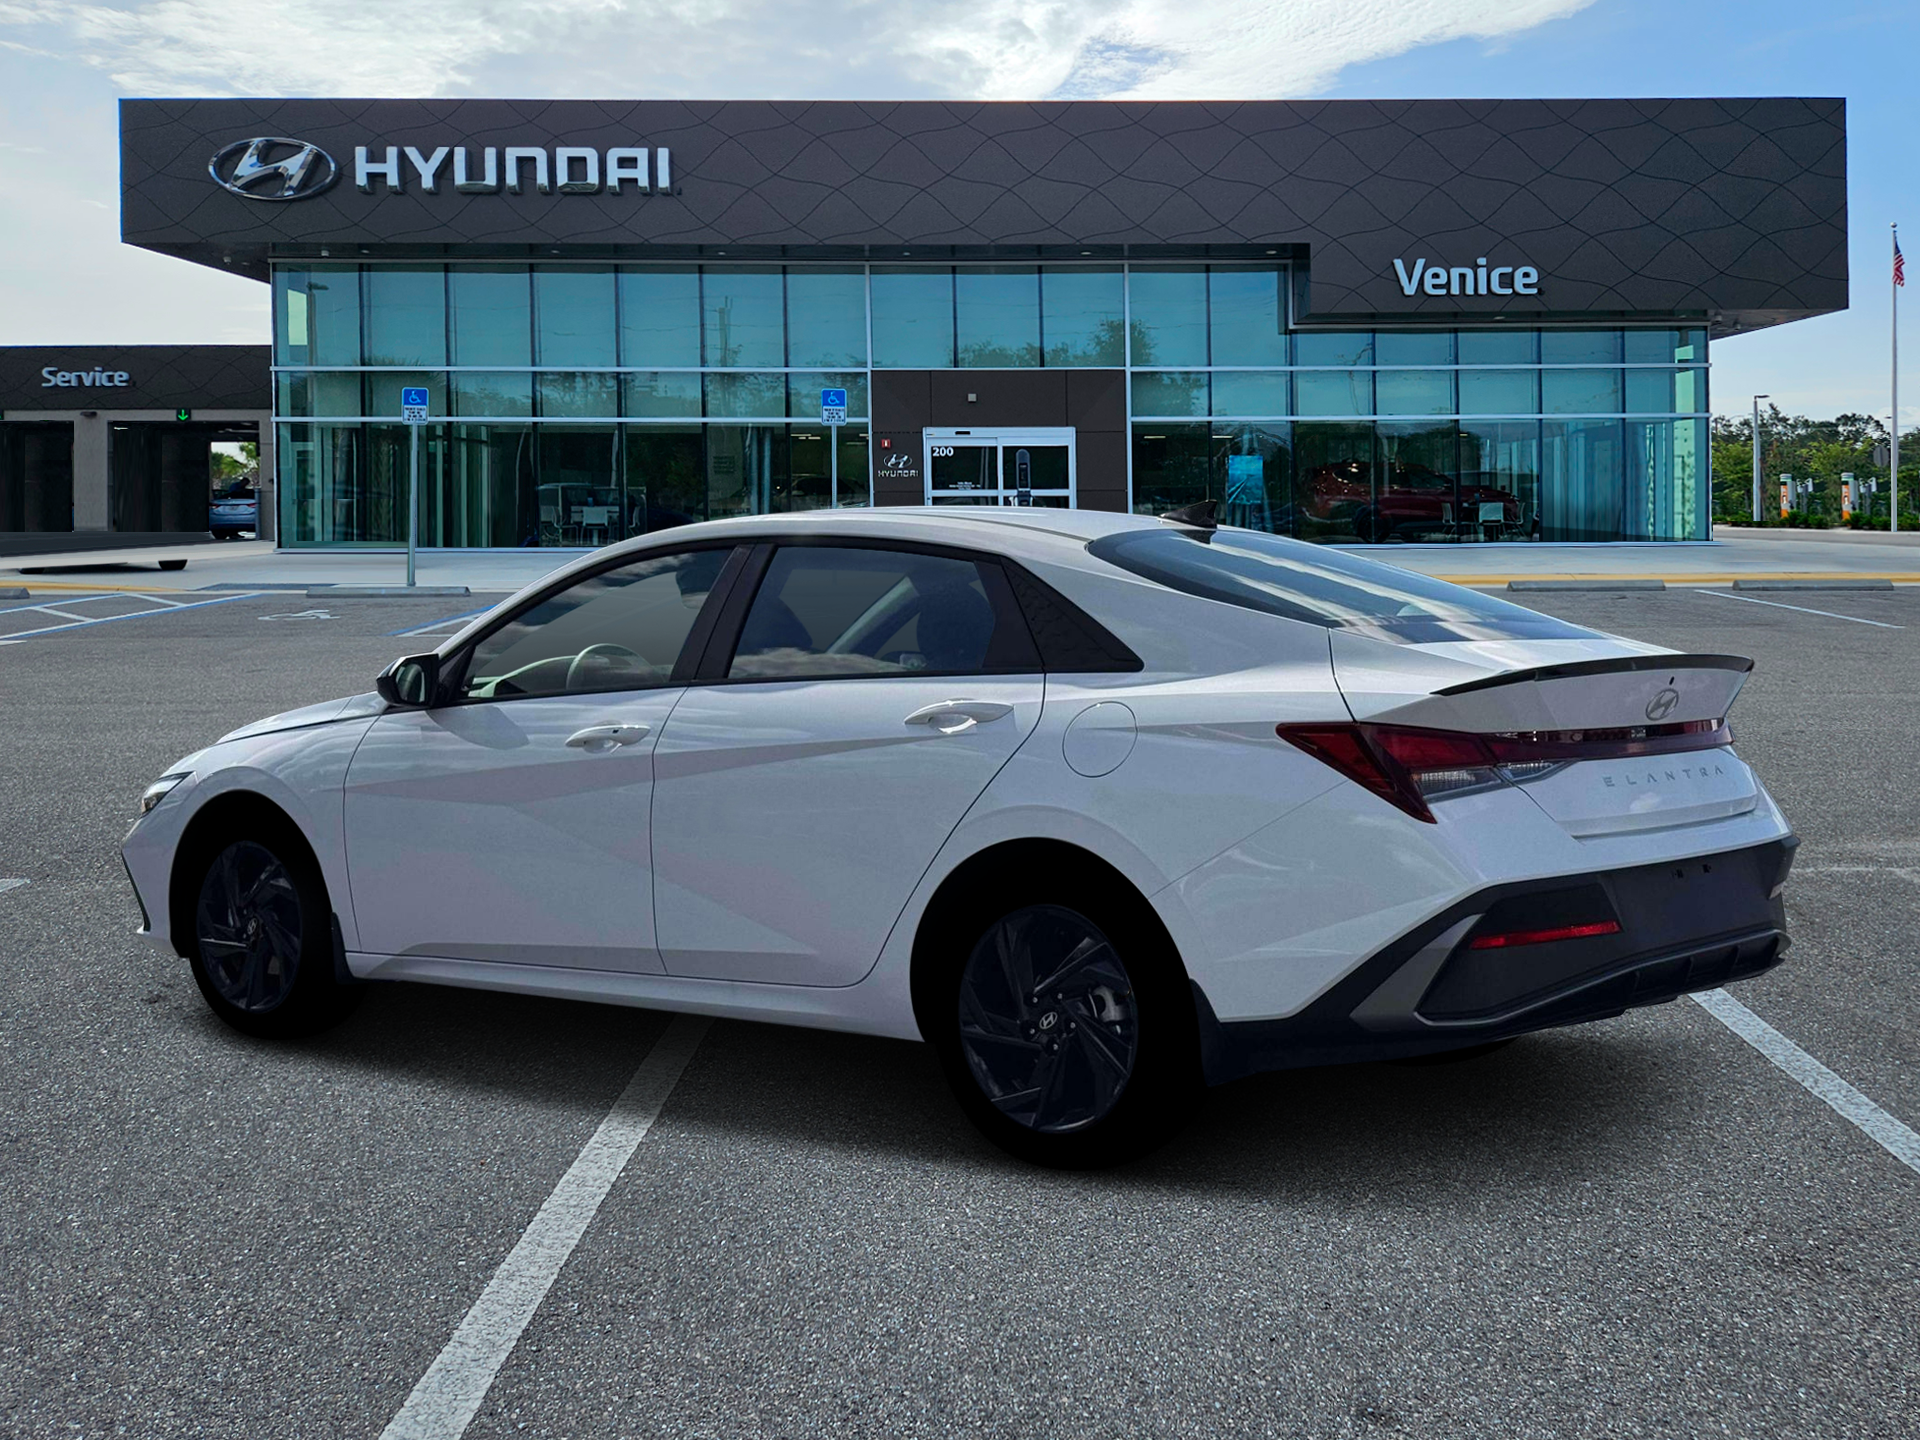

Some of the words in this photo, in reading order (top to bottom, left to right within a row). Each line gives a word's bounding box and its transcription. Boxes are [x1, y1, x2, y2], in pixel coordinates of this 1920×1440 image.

[355, 146, 671, 194] HYUNDAI
[1393, 257, 1539, 296] Venice
[41, 366, 130, 387] Service
[932, 446, 954, 457] 200
[877, 469, 919, 478] HYUNDAI
[1602, 764, 1724, 788] ELANTRA
